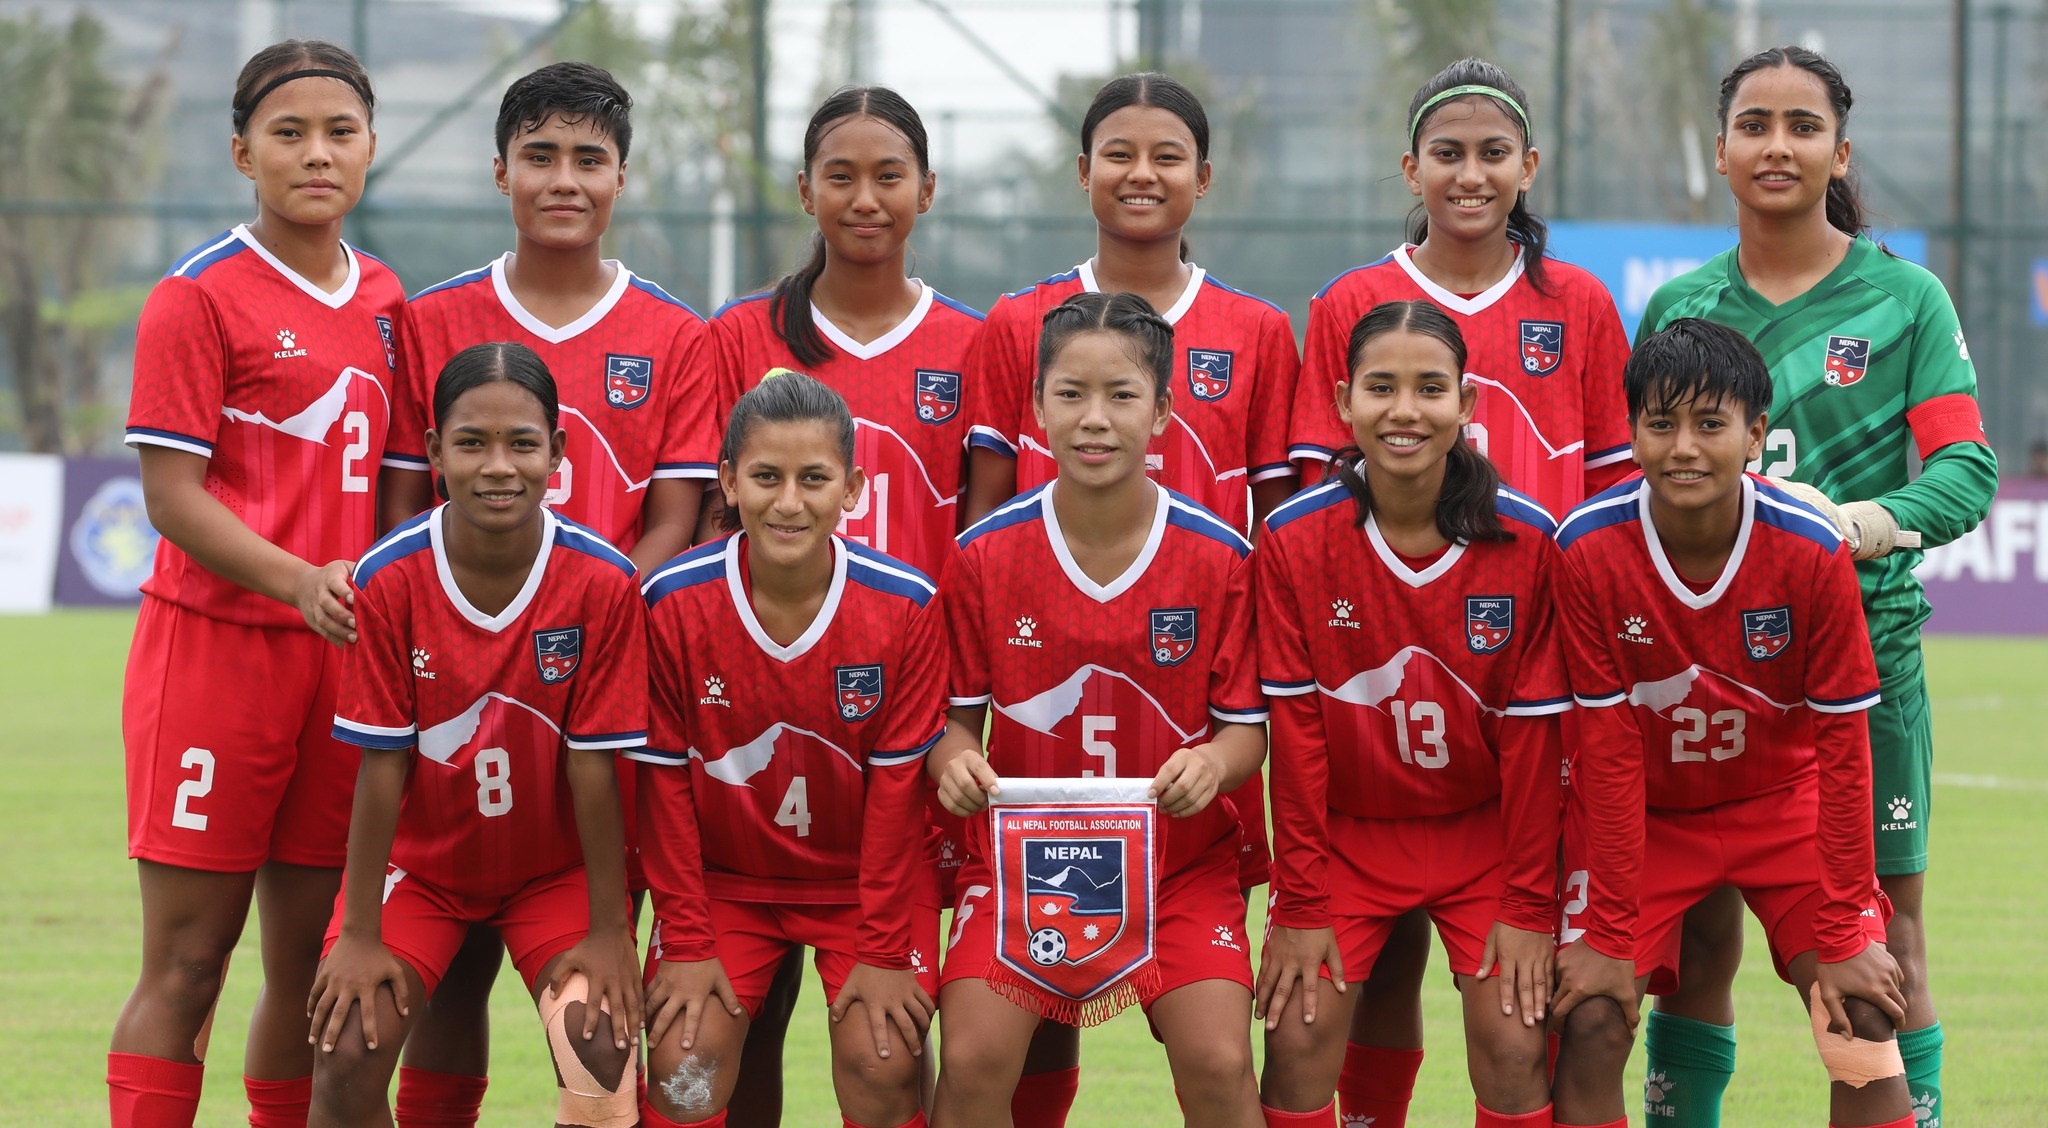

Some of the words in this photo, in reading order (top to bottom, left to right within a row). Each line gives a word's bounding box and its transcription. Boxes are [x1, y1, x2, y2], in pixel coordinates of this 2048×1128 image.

[1839, 339, 1859, 347] NEPAL
[275, 349, 307, 359] KELME
[620, 360, 640, 368] NEPAL
[928, 375, 948, 383] NEPAL
[342, 411, 369, 493] 2
[1755, 614, 1777, 622] NEPAL
[1328, 619, 1360, 629] KELME
[548, 634, 568, 642] NEPAL
[1008, 637, 1042, 648] KELME
[1617, 632, 1653, 644] KELME
[849, 671, 869, 679] NEPAL
[700, 697, 731, 708] KELME
[1390, 699, 1450, 769] 13
[1671, 706, 1746, 763] 23
[1082, 715, 1116, 778] 5
[474, 747, 514, 818] 8
[171, 746, 216, 832] 2
[773, 776, 812, 838] 4
[1007, 820, 1021, 830] ALL
[1023, 820, 1047, 830] NEPAL
[1049, 820, 1088, 830] FOOTBALL
[1090, 819, 1141, 830] ASSOCIATION
[1881, 821, 1917, 831] KELME
[1044, 846, 1102, 860] NEPAL
[1211, 938, 1242, 953] KELME
